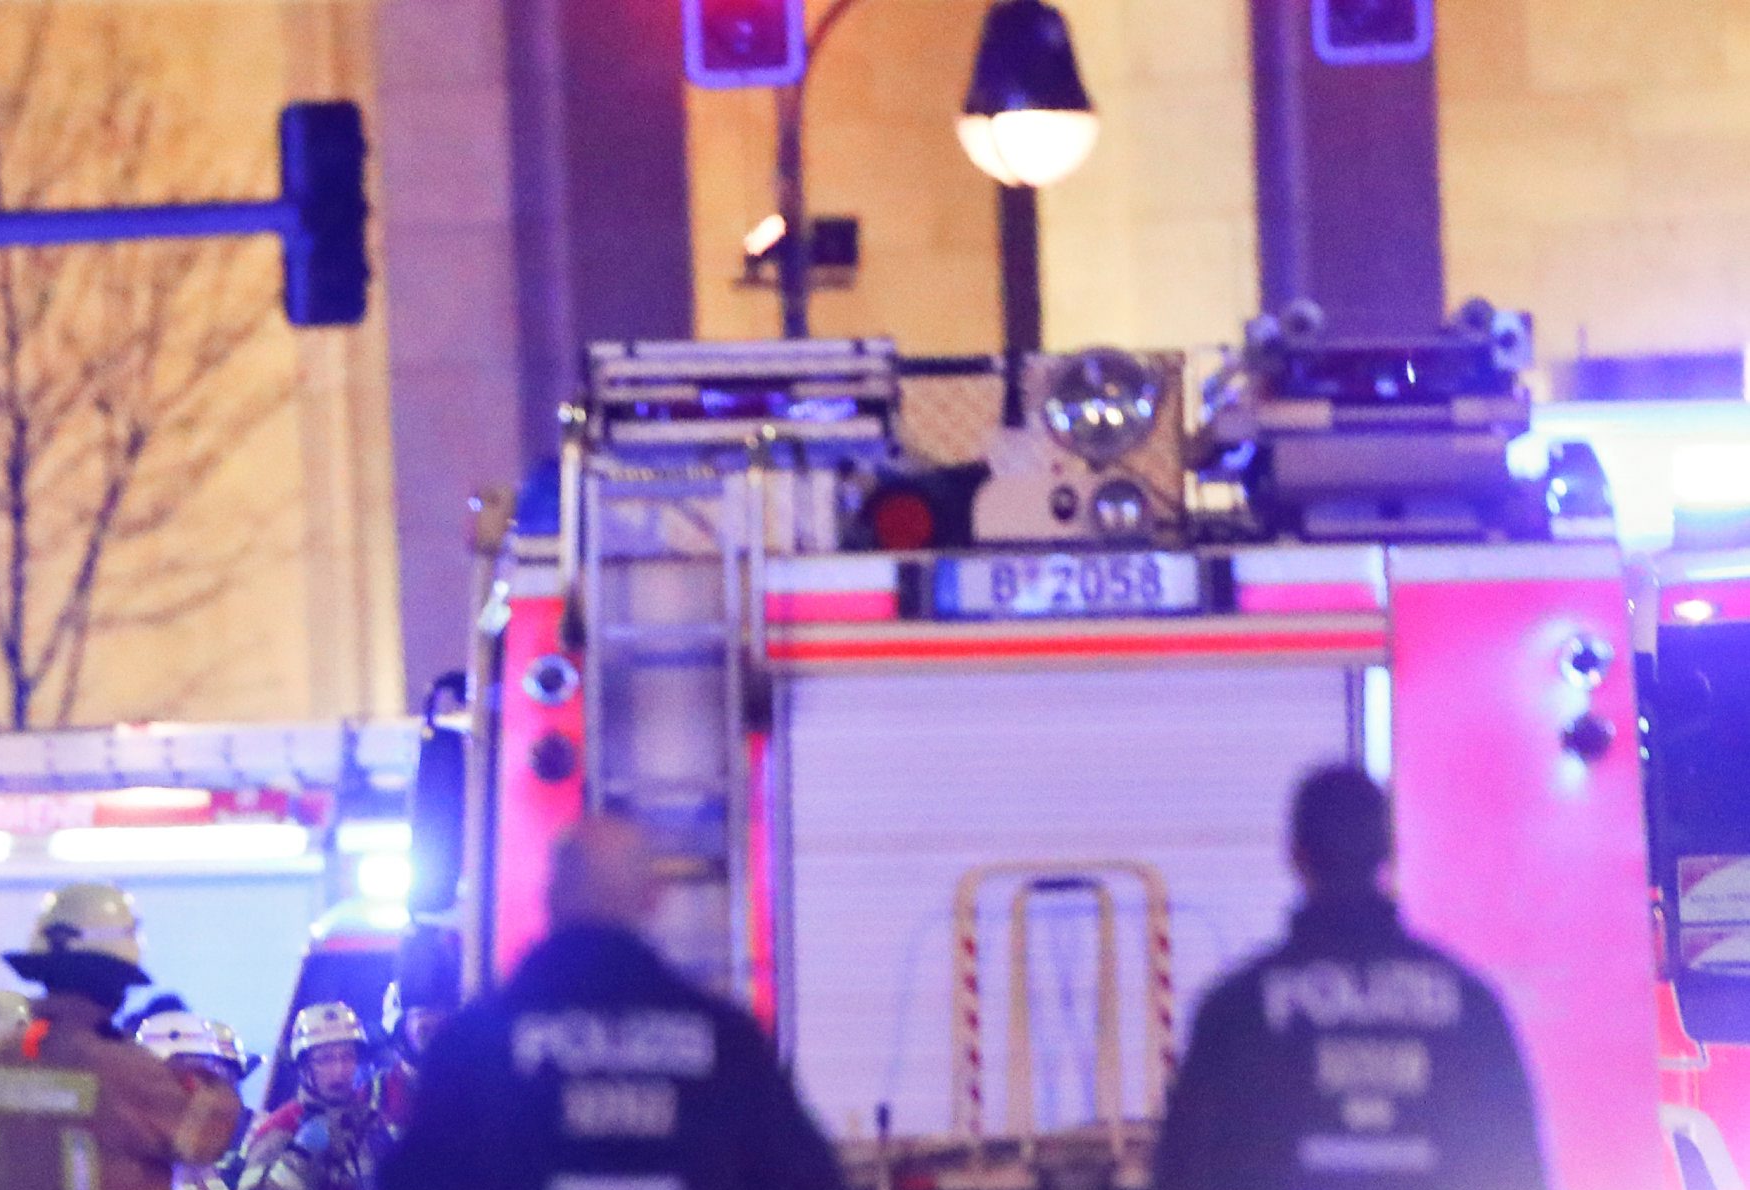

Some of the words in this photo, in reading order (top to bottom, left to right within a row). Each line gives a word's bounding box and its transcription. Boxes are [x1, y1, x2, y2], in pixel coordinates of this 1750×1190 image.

[989, 558, 1018, 603] B
[1051, 556, 1162, 603] 2058
[1263, 958, 1463, 1032] POLIZEI
[512, 1008, 717, 1078] POLIZEI
